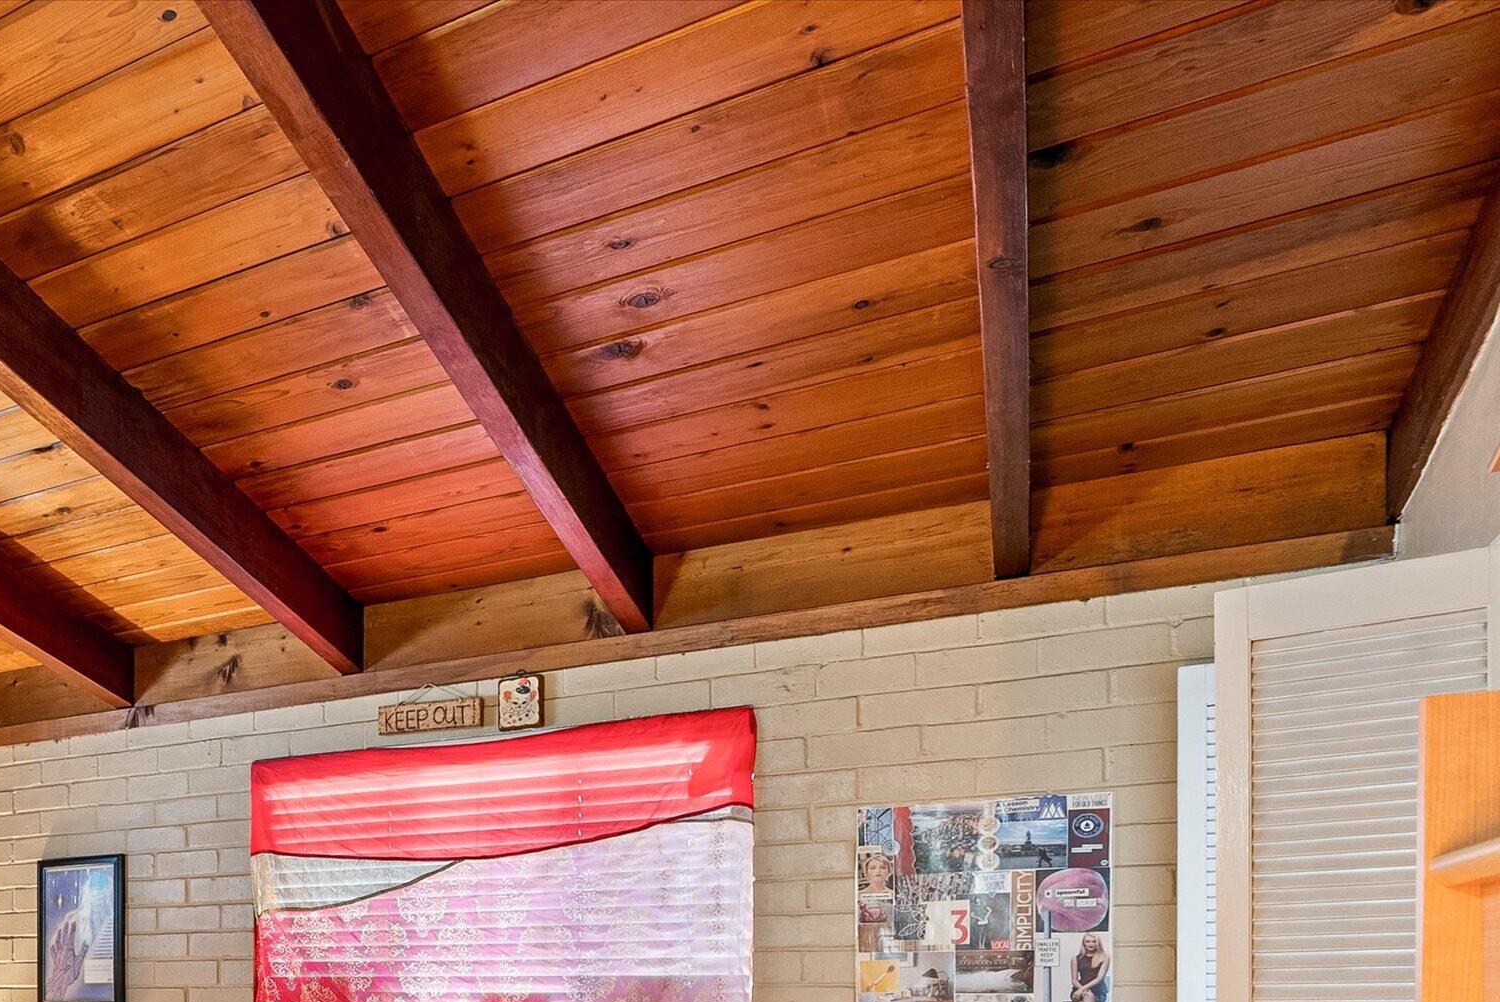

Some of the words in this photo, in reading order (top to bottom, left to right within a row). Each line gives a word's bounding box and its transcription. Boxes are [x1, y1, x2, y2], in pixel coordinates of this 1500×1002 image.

[385, 708, 429, 731] KEEP
[433, 704, 471, 725] OUT
[1004, 805, 1040, 813] Chemistry
[1016, 870, 1032, 950] SIMPLICITY
[951, 910, 968, 945] 3
[991, 940, 1010, 949] LOCAL
